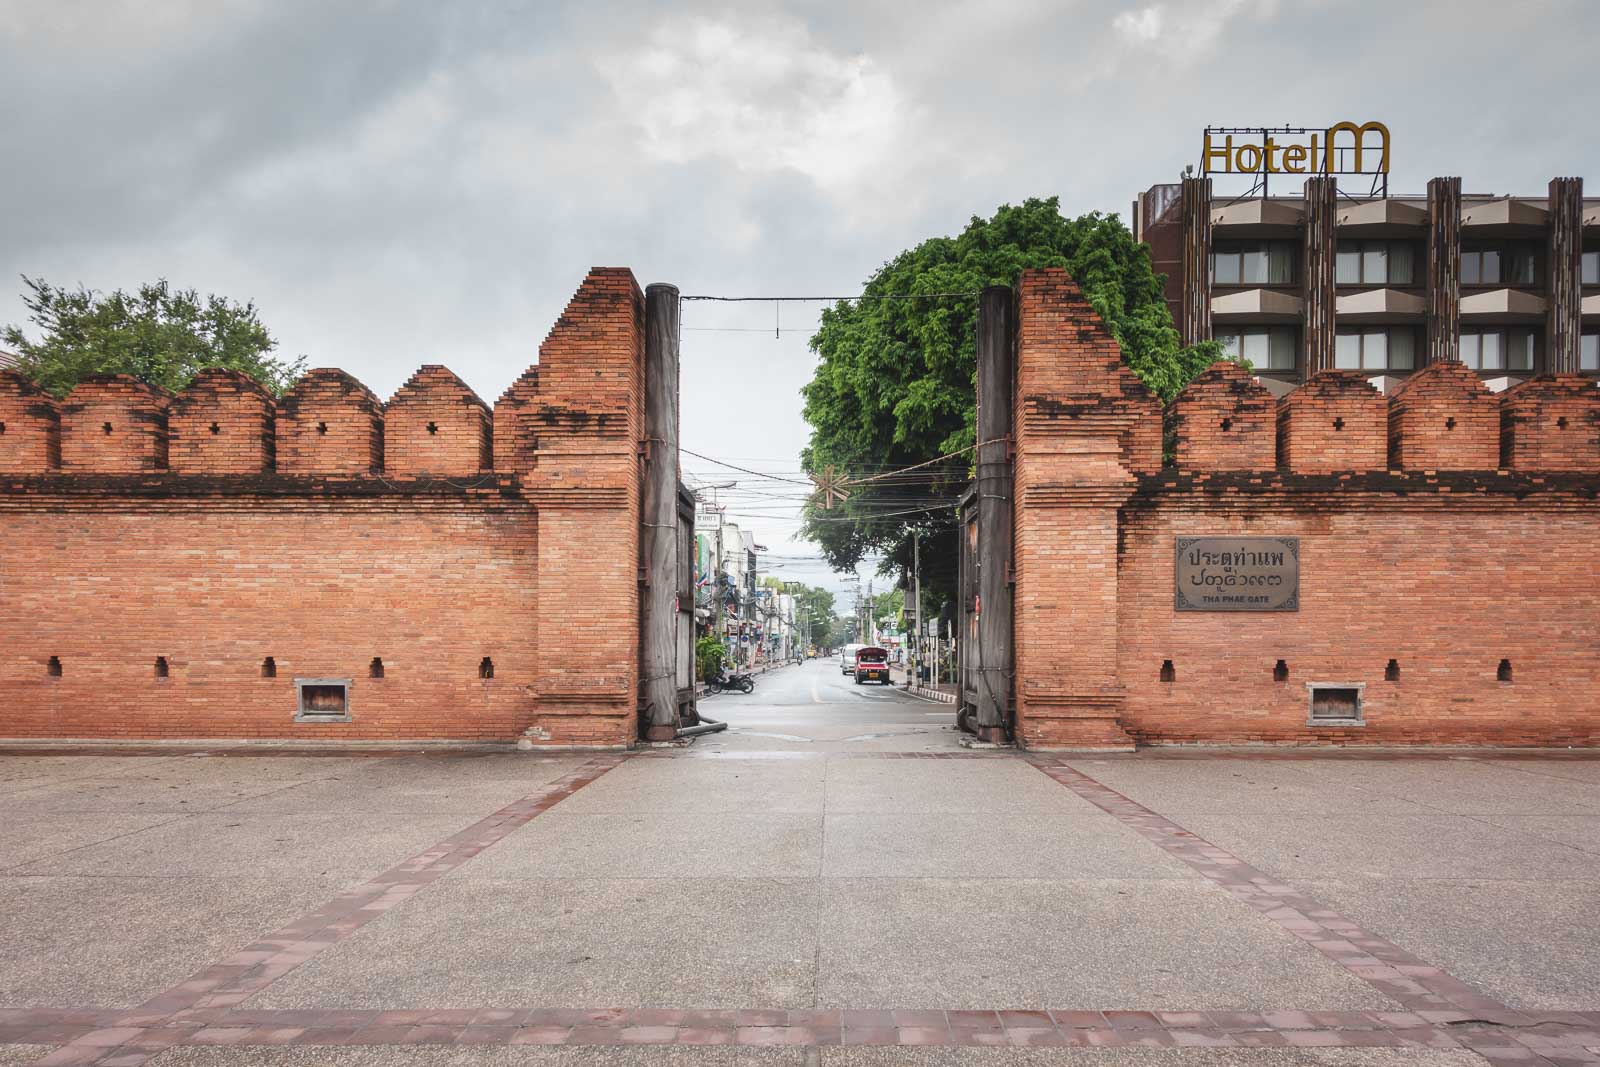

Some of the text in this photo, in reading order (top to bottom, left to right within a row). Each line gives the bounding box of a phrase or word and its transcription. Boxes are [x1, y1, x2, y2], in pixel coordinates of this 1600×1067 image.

[1205, 134, 1318, 173] Hotel
[1189, 547, 1284, 573] ประตูท่าแพ
[1202, 596, 1270, 604] THA PHAE GATE
